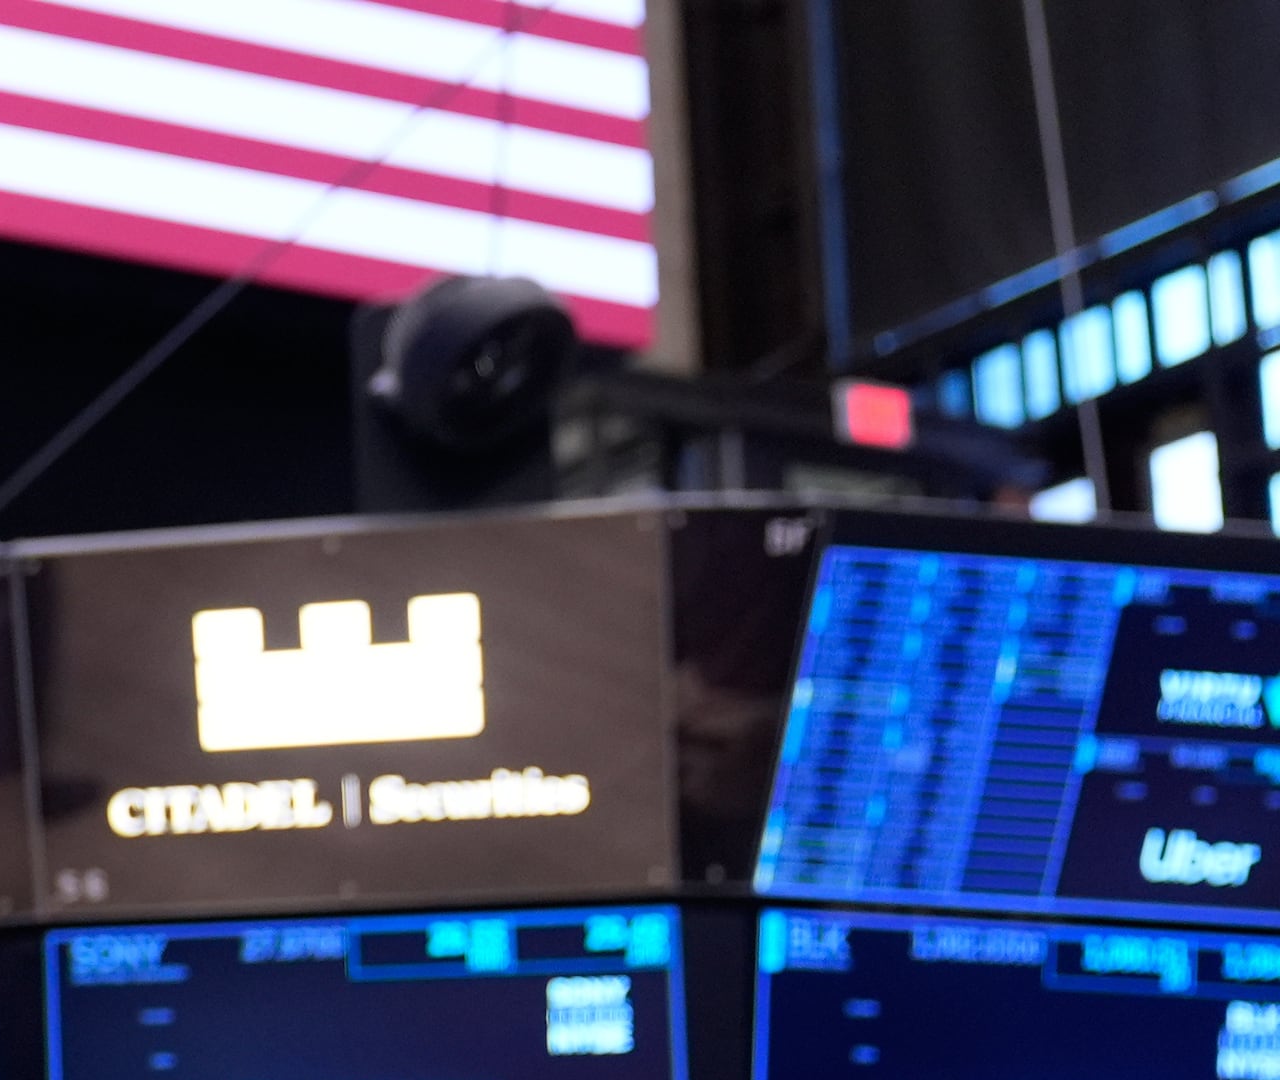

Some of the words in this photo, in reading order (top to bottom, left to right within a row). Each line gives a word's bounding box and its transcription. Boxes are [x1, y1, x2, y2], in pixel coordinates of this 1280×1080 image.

[108, 779, 332, 836] CITADEL
[370, 767, 589, 824] Securities
[1140, 827, 1262, 886] Uber
